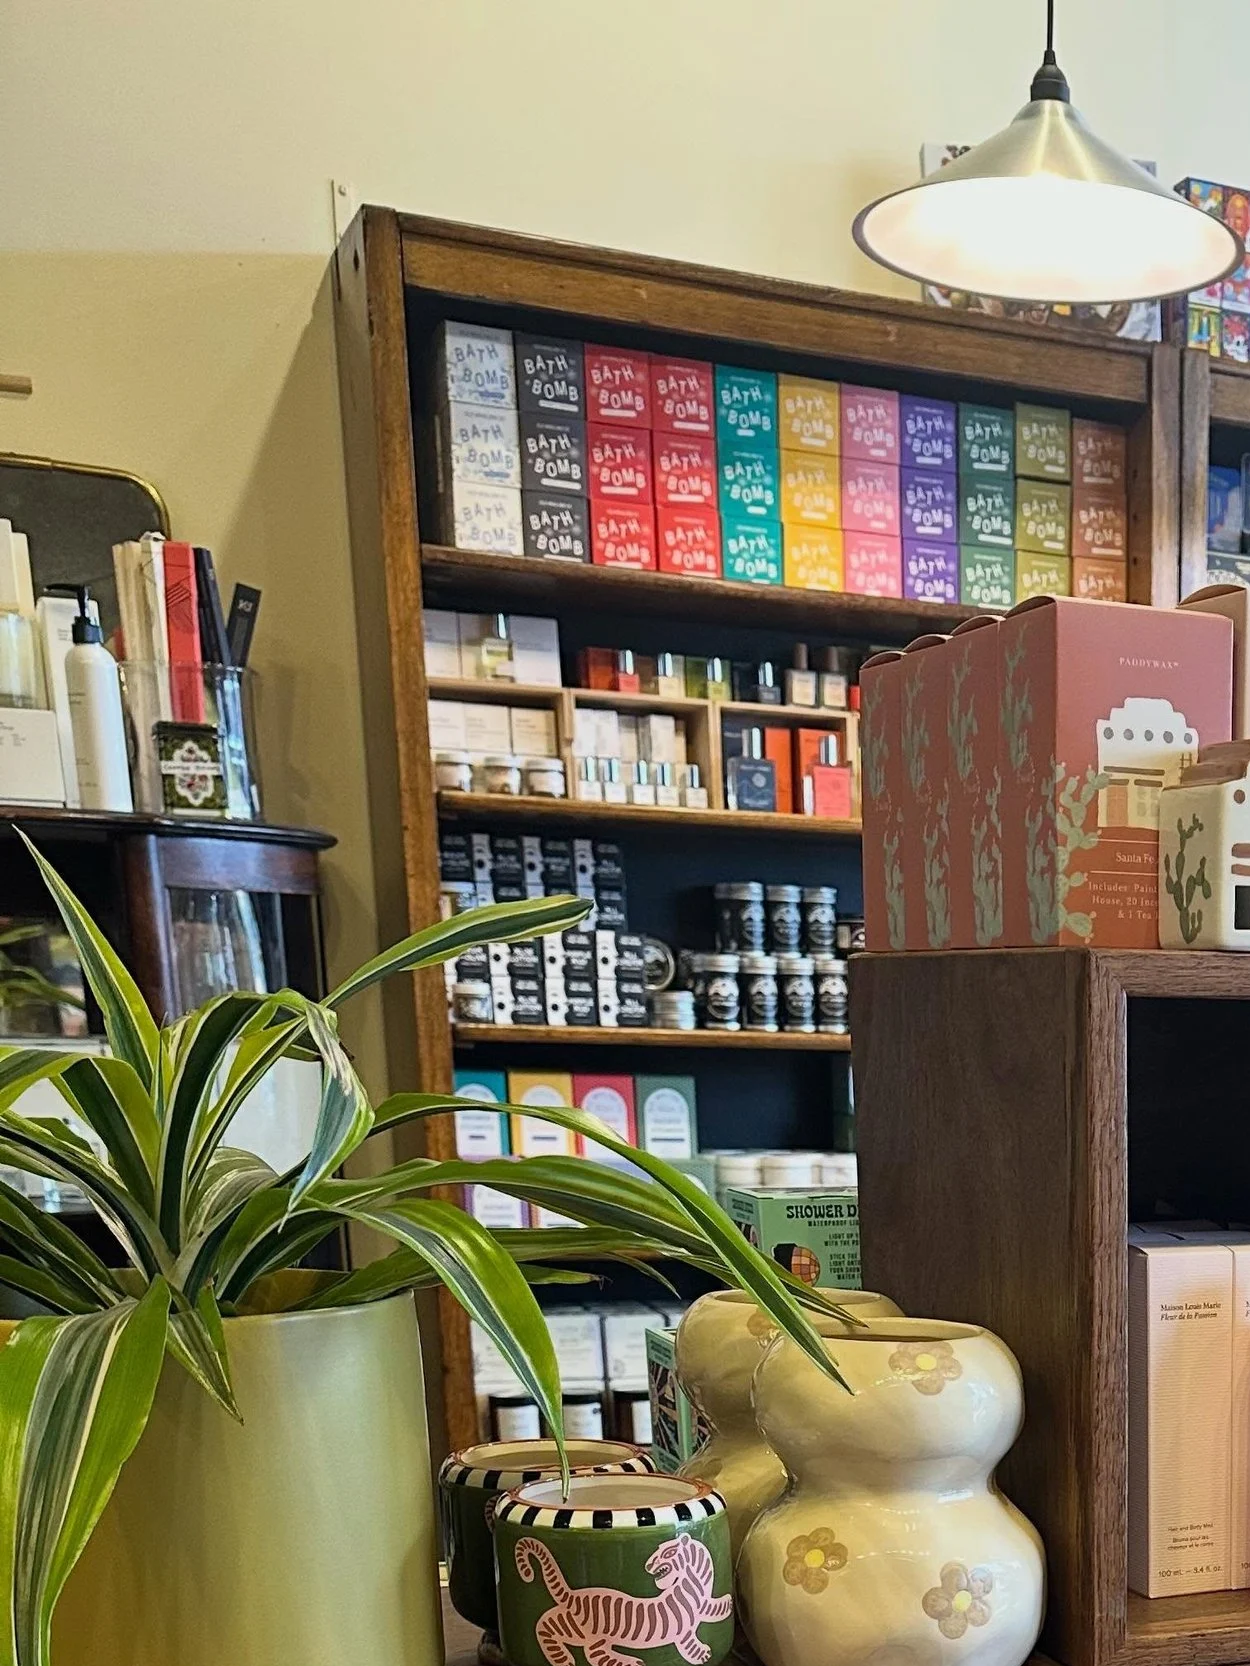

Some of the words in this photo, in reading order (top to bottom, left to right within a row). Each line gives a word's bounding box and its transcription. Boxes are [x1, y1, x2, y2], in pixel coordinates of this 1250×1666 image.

[524, 354, 569, 375] BATH
[590, 366, 634, 384] BATH
[656, 376, 700, 394] BATH
[531, 378, 578, 401] BOMB
[721, 386, 761, 404] BATH
[599, 389, 644, 411] BOMB
[664, 400, 709, 421] BOMB
[727, 409, 772, 430] BOMB
[905, 416, 945, 435] BATH
[526, 434, 571, 454] BATH
[912, 438, 953, 459] BOMB
[534, 458, 581, 480] BOMB
[724, 463, 765, 481] BATH
[730, 484, 774, 505] BOMB
[966, 494, 1004, 512] BATH
[529, 511, 574, 532] BATH
[971, 515, 1012, 535] BOMB
[536, 535, 584, 556] BOMB
[908, 556, 946, 576] BATH
[914, 579, 955, 598] BOMB
[1115, 852, 1142, 864] Santa
[1089, 881, 1128, 892] Includes
[786, 1204, 844, 1219] SHOWER
